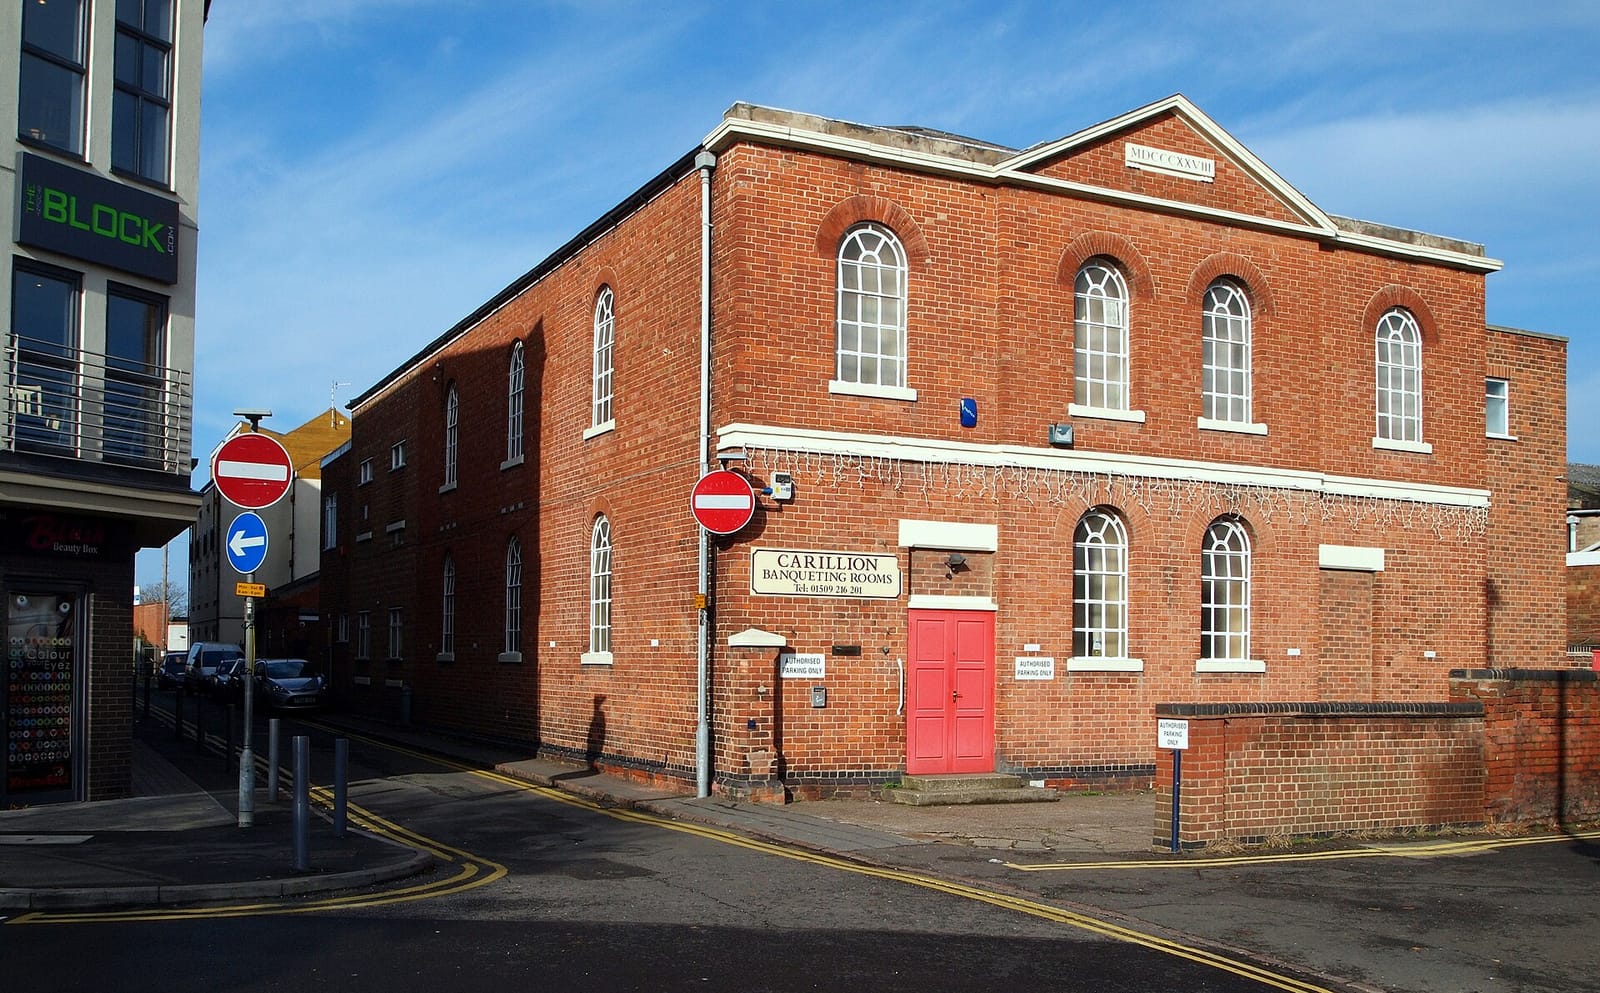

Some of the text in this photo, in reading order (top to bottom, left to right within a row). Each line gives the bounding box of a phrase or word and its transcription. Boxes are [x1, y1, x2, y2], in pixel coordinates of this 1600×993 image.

[1131, 147, 1211, 174] MDCCCXXVIII
[25, 183, 36, 213] THE
[43, 187, 165, 254] BLOCK
[53, 542, 98, 555] Beauty Box
[777, 554, 879, 572] CARILLION
[763, 569, 893, 585] BANQUETING ROOMS
[793, 584, 863, 595] Tel: 01509 216 201
[44, 660, 71, 672] Eyez
[785, 657, 821, 665] AUTHORISED
[1020, 660, 1051, 668] AUTHORISED
[1040, 669, 1052, 677] ONLY
[1160, 721, 1187, 730] AUTHORISED
[1163, 730, 1183, 738] PARKING
